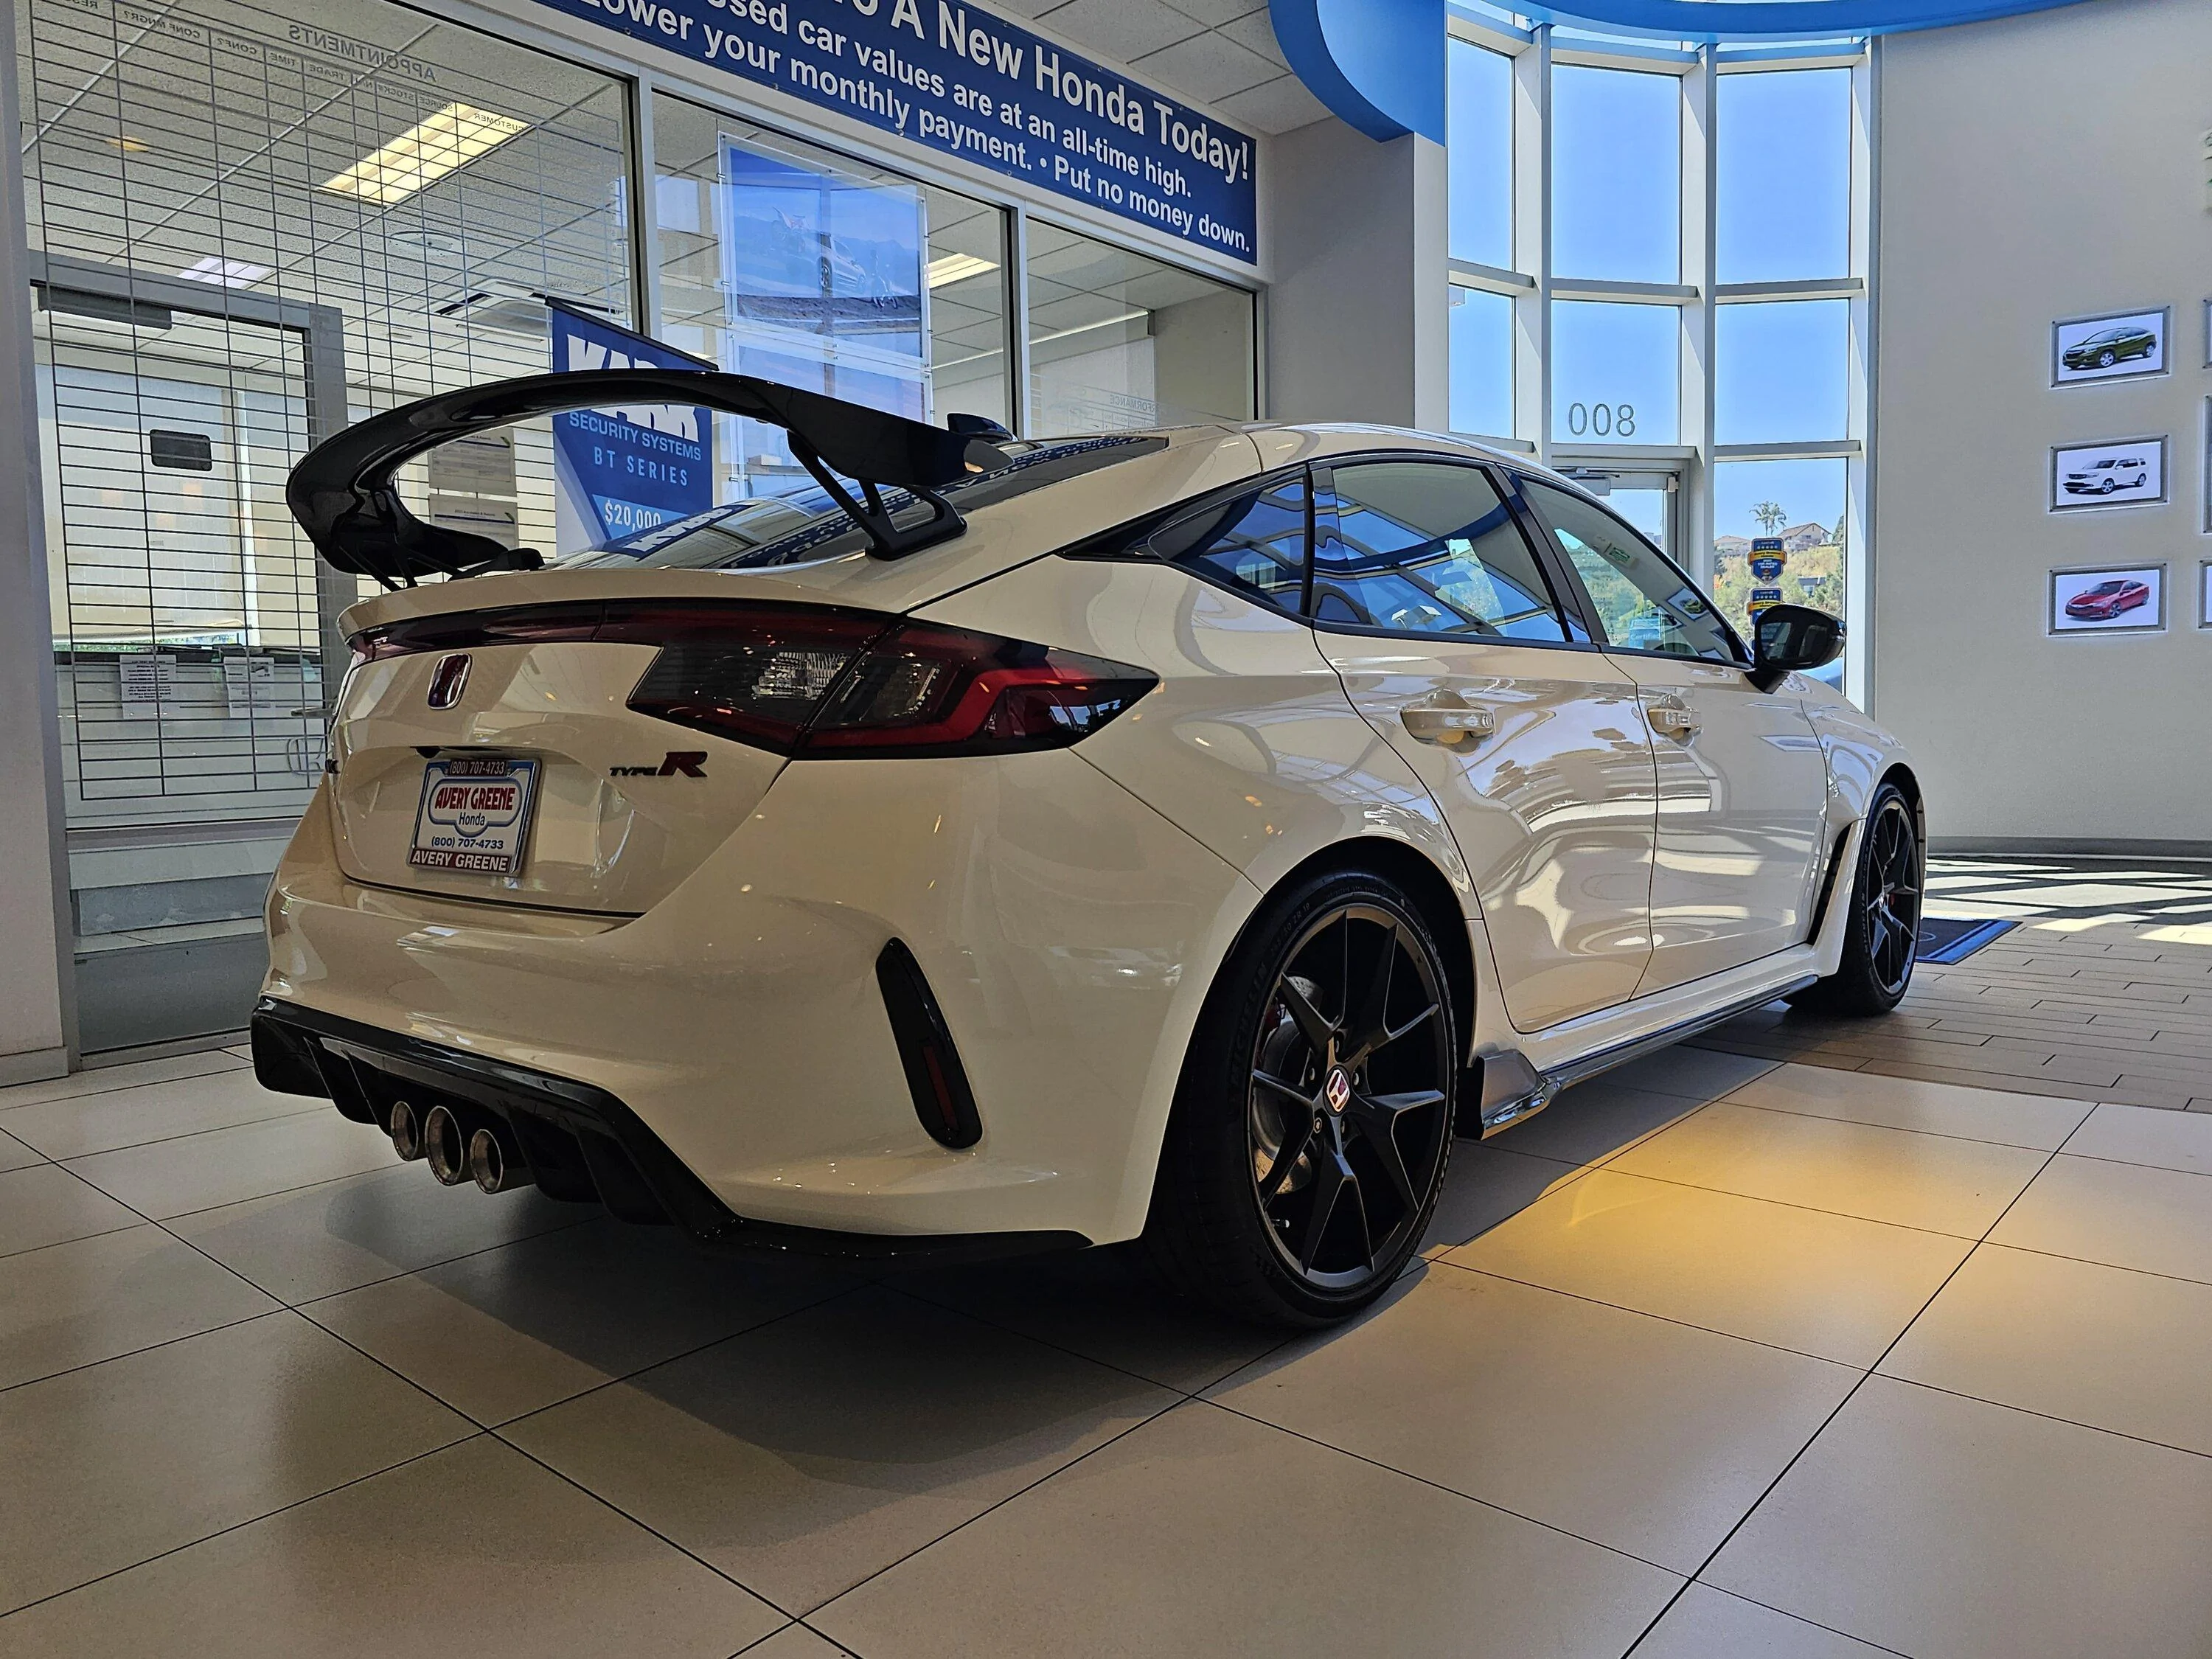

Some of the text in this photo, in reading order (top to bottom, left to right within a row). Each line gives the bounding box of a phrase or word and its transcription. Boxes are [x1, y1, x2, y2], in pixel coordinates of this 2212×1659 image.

[706, 0, 1192, 197] sed car values are at an all-time high.
[891, 0, 1249, 184] A New Honda Today!
[583, 0, 1251, 252] ower your monthly payment. Put no money down.
[569, 411, 701, 462] SECURITY SYSTEMS
[594, 445, 688, 487] BT SERIES
[605, 499, 661, 532] $20,000
[450, 761, 504, 774] (800) 707-4733
[657, 751, 708, 778] R
[434, 787, 515, 810] AVERY GREENE
[459, 812, 485, 827] Honda
[431, 835, 504, 849] (800) 707-4733
[411, 850, 509, 872] AVERY GREENE
